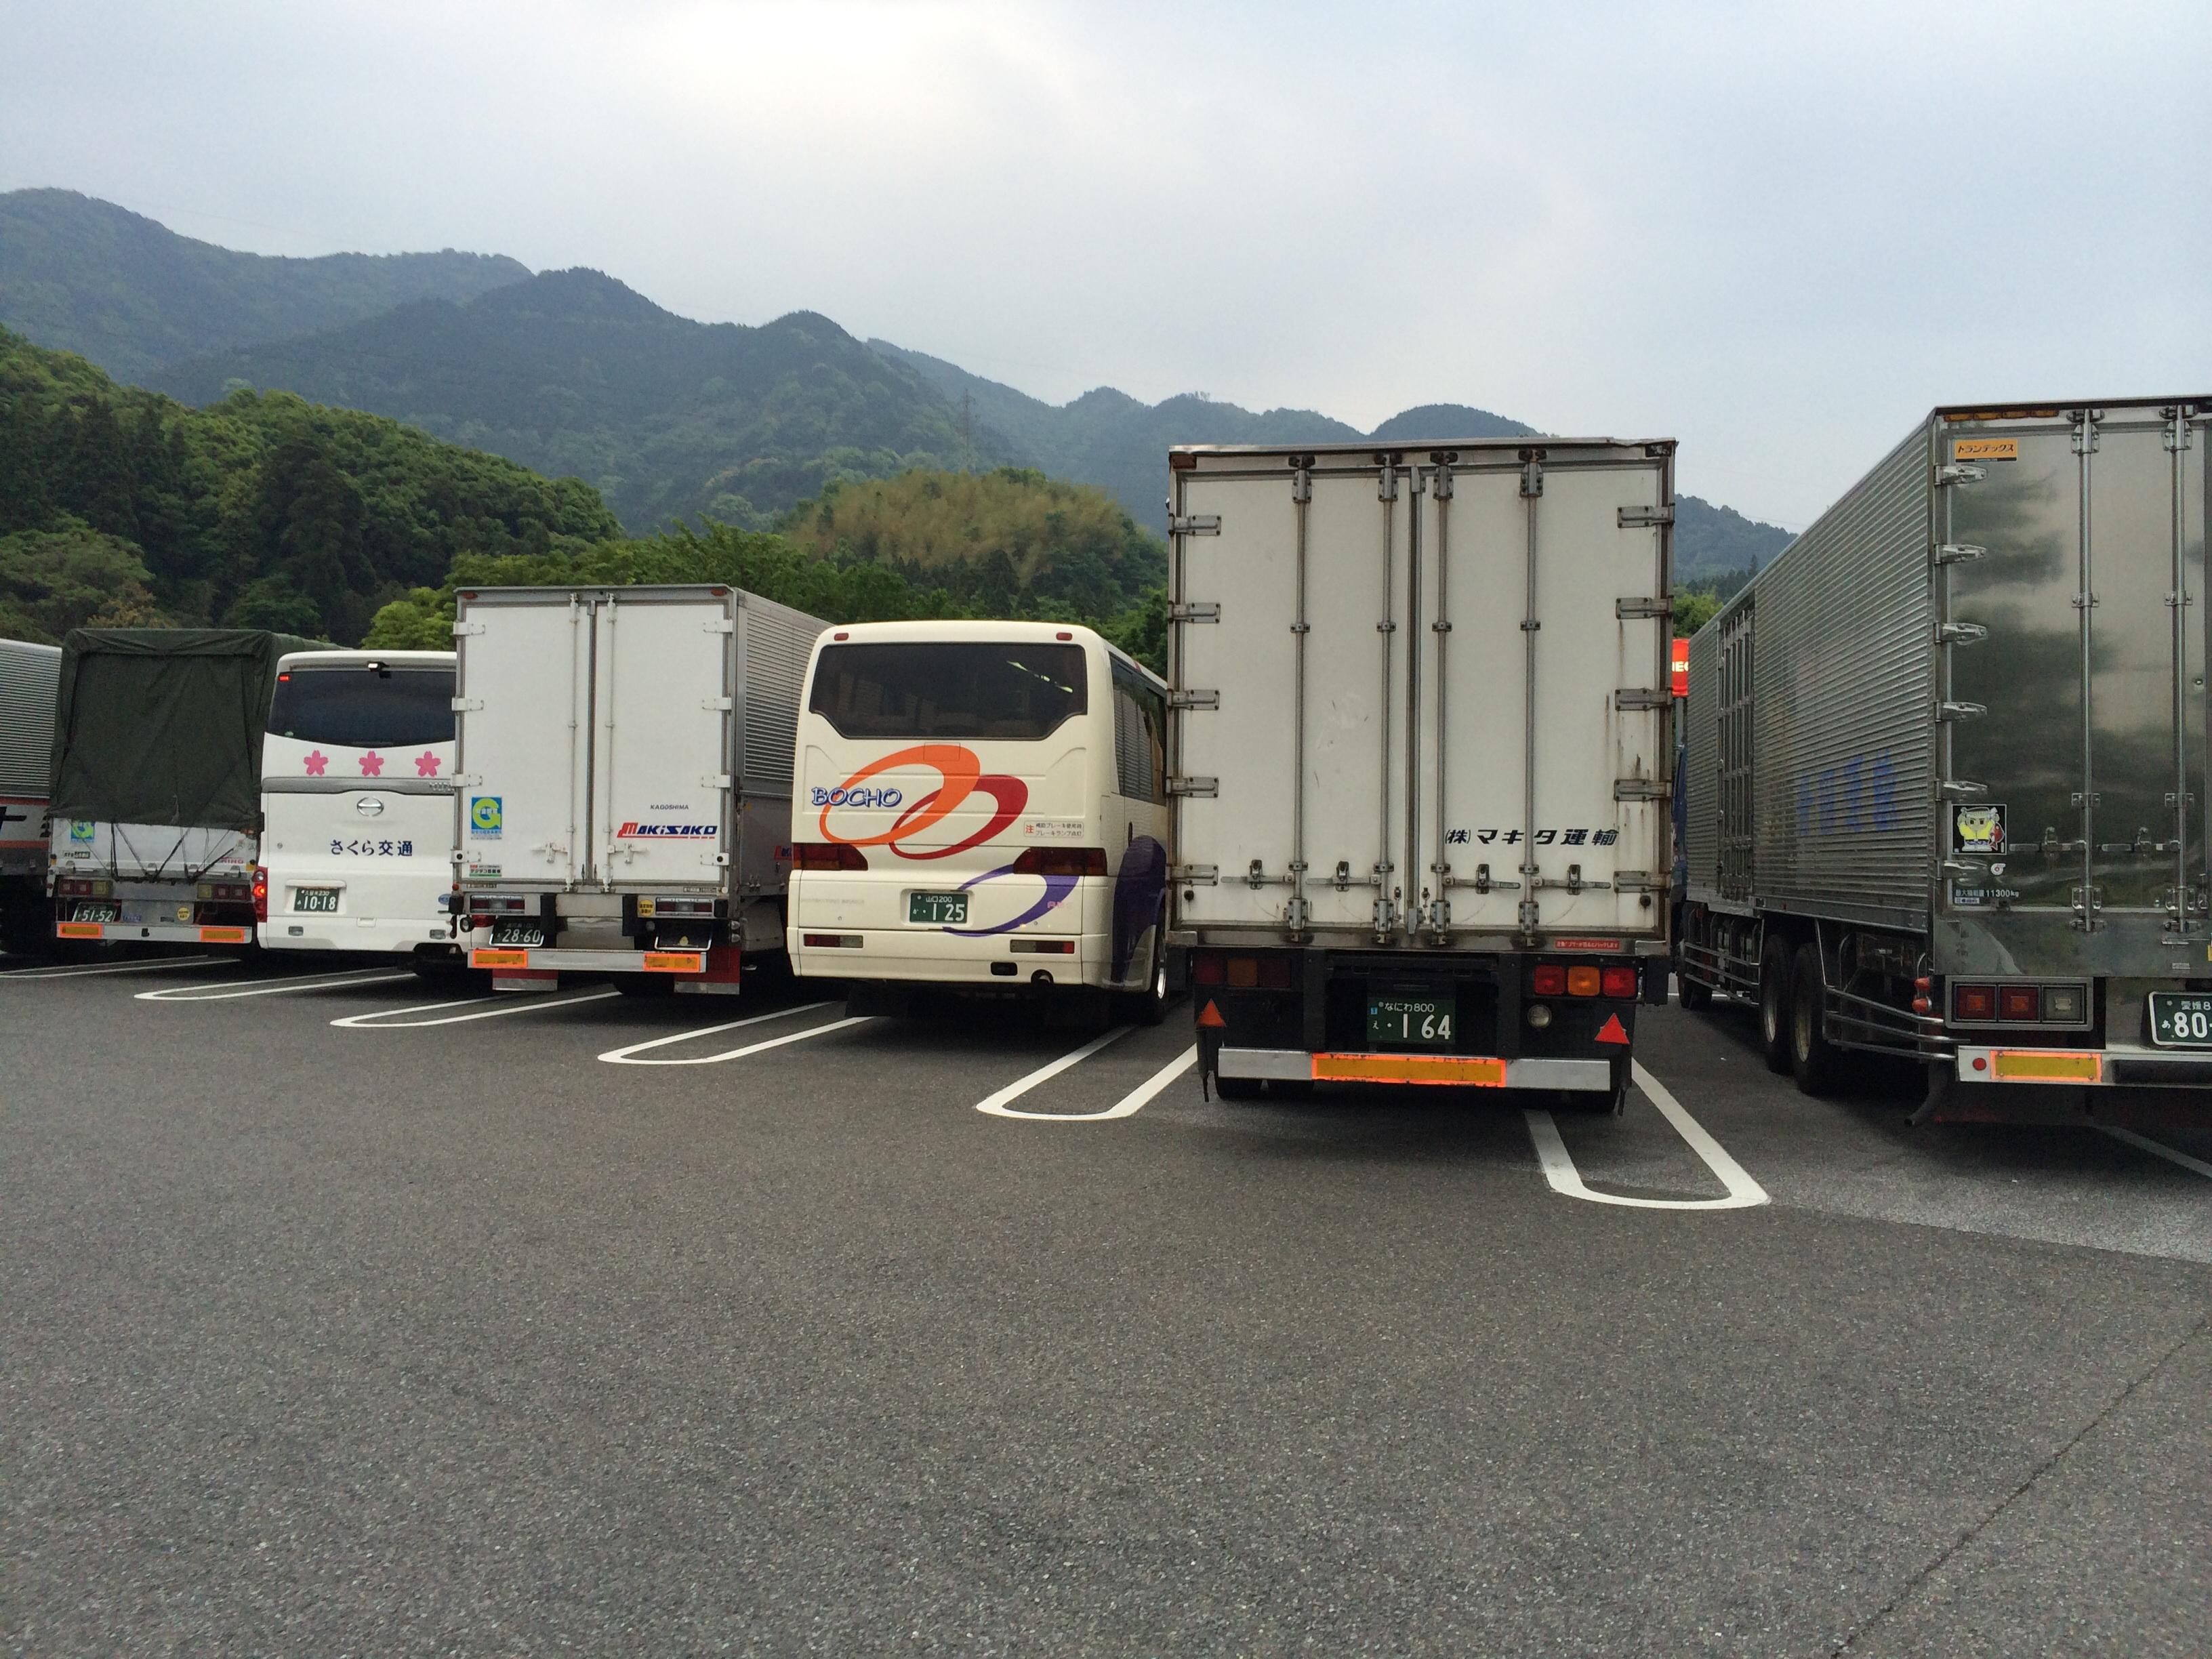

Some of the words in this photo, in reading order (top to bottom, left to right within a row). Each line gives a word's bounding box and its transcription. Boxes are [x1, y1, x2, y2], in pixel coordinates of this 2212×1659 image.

[811, 787, 903, 807] BOCHO
[1025, 824, 1033, 834] 注
[330, 840, 413, 856] さくら交通
[303, 896, 337, 910] 10-18
[501, 928, 541, 943] 28-60
[1385, 1002, 1435, 1012] なにわ800
[2161, 1019, 2171, 1029] あ
